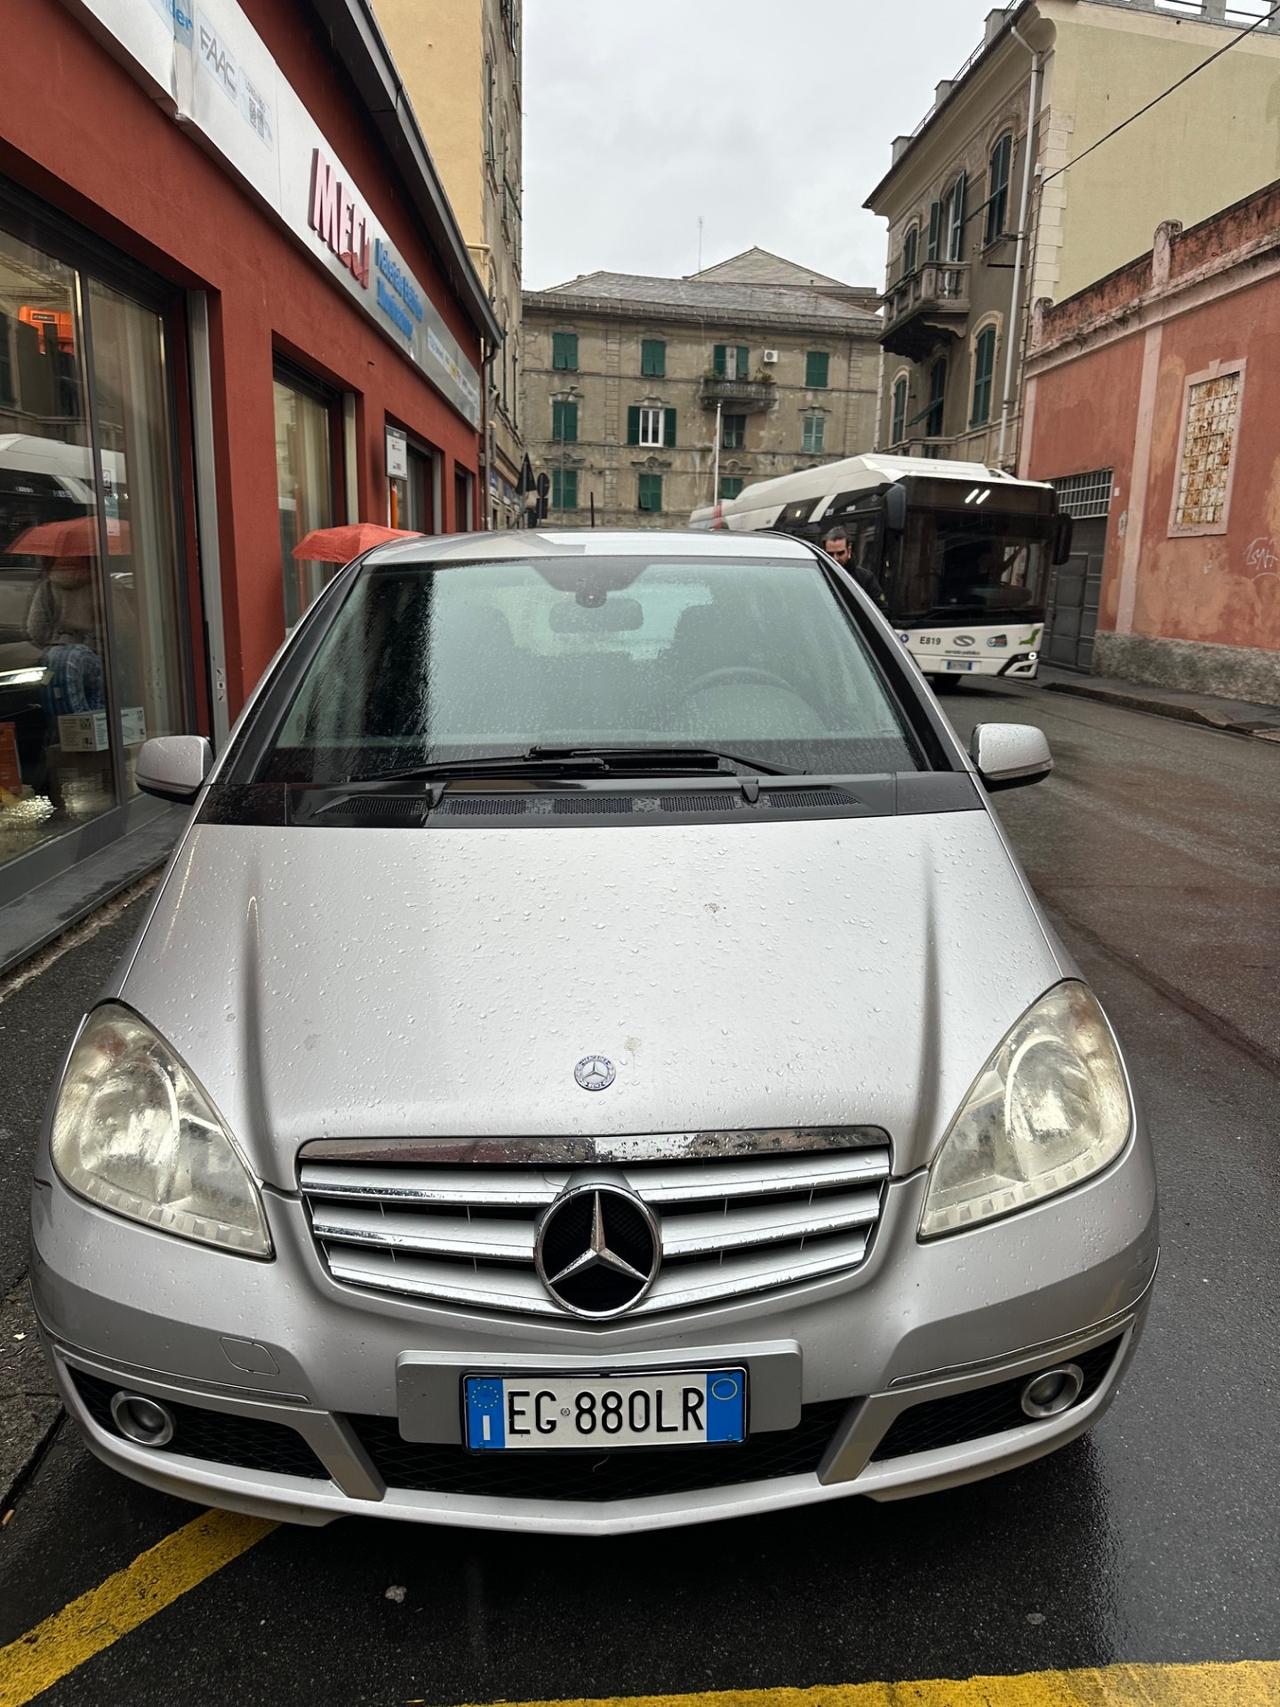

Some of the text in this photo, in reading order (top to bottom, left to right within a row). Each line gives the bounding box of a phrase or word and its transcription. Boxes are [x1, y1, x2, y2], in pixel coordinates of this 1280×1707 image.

[200, 25, 236, 93] FAAC
[920, 636, 941, 645] E819
[508, 1390, 557, 1435] EG
[575, 1387, 705, 1435] 880LR
